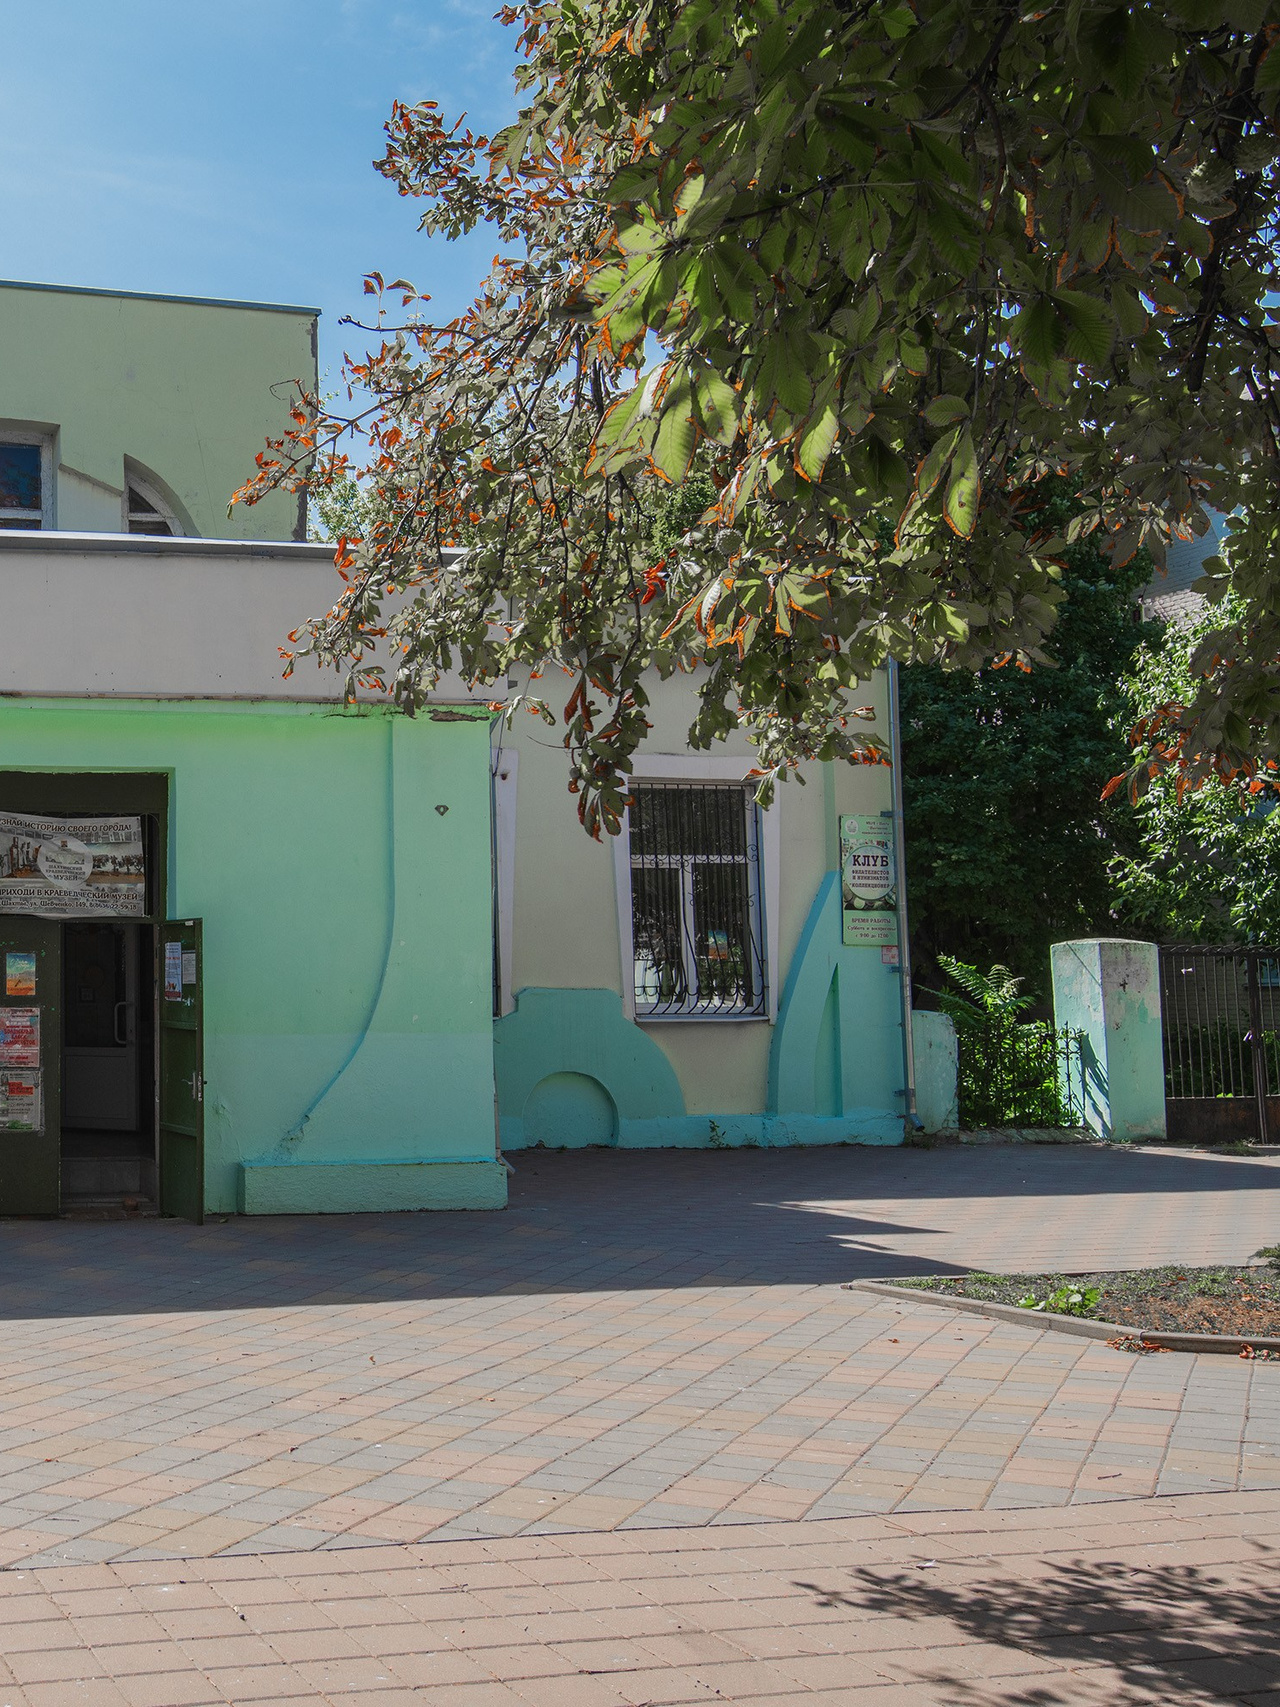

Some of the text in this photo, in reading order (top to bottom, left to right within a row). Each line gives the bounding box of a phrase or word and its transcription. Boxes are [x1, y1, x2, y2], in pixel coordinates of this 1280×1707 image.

[24, 822, 66, 832] ИСТОРИЮ
[99, 824, 131, 832] ГОРОДА!
[852, 854, 889, 867] КЛУБ
[37, 888, 43, 896] В
[44, 888, 110, 900] КРАЕВЕДЧЕСКИЙ
[112, 892, 138, 901] МУЗЕЙ
